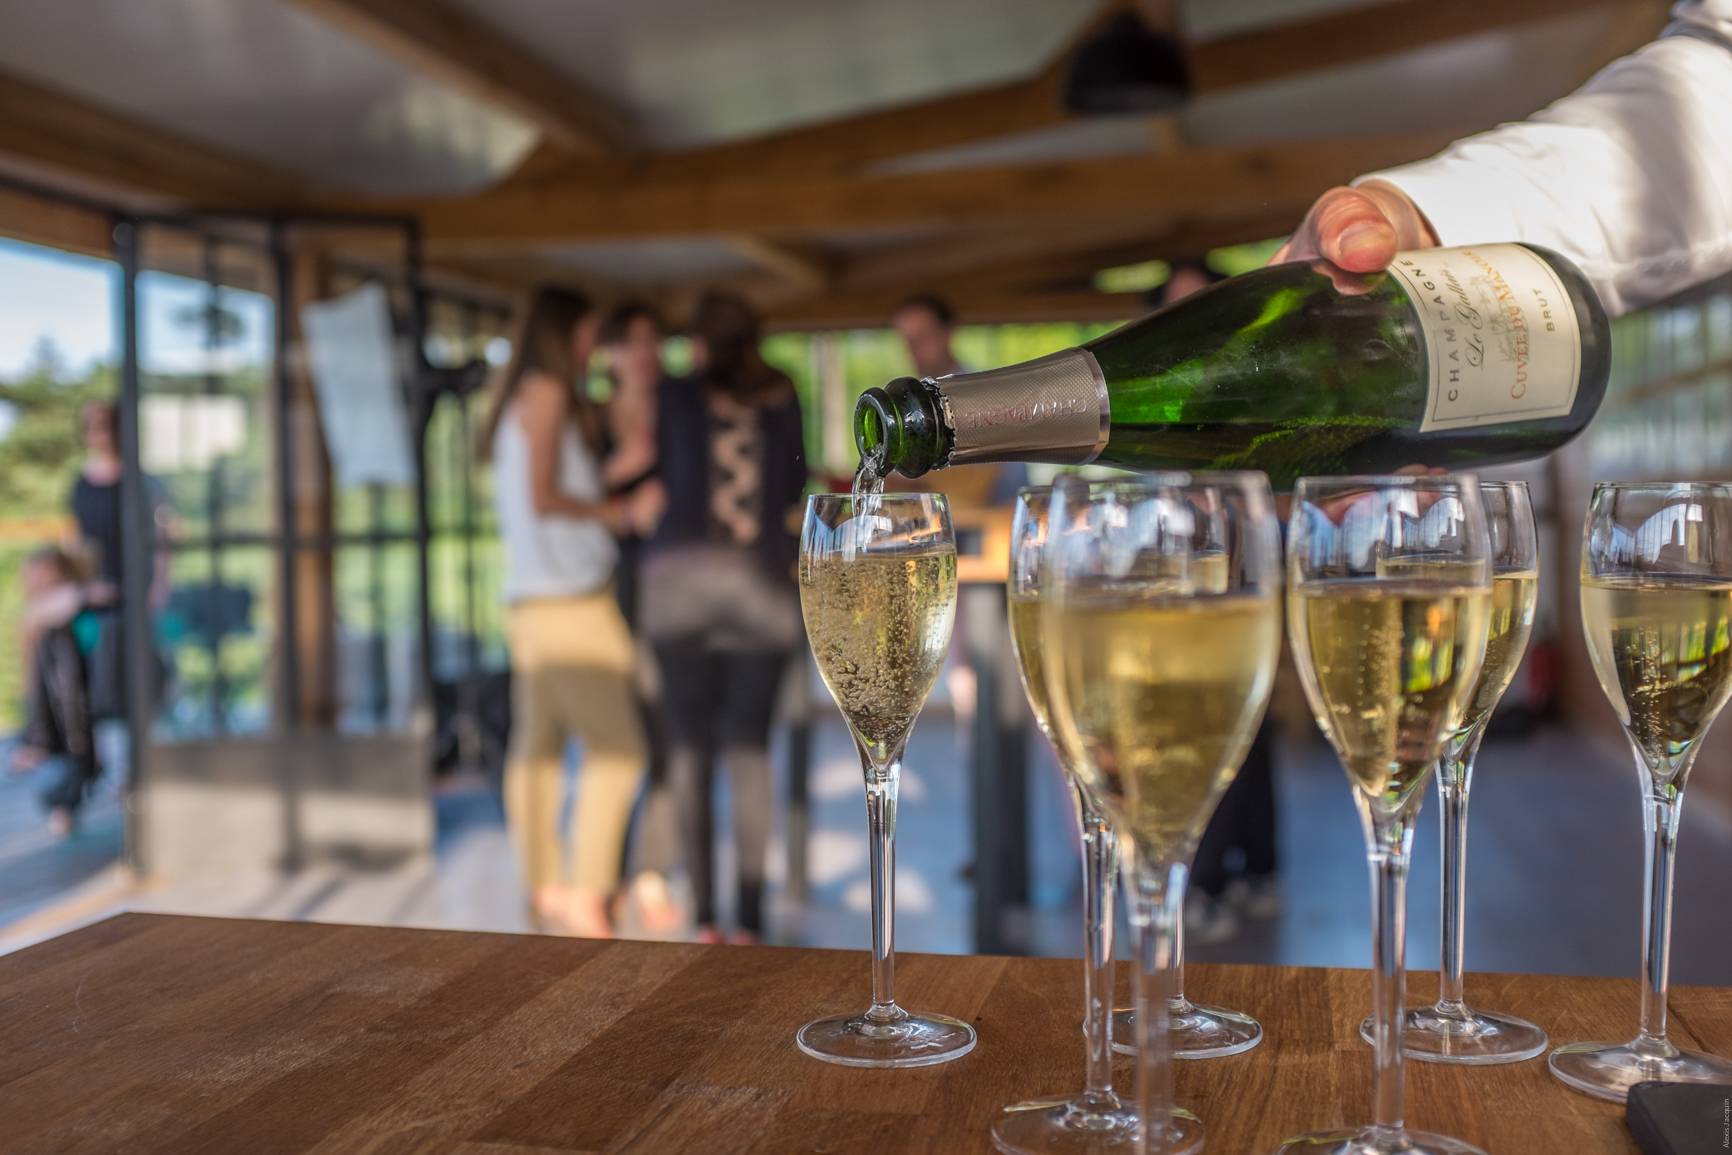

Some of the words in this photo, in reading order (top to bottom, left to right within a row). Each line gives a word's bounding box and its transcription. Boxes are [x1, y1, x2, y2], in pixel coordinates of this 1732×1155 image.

[1400, 259, 1460, 402] CHAMPAGNE
[1532, 287, 1556, 332] BRUT
[1464, 331, 1485, 371] Le
